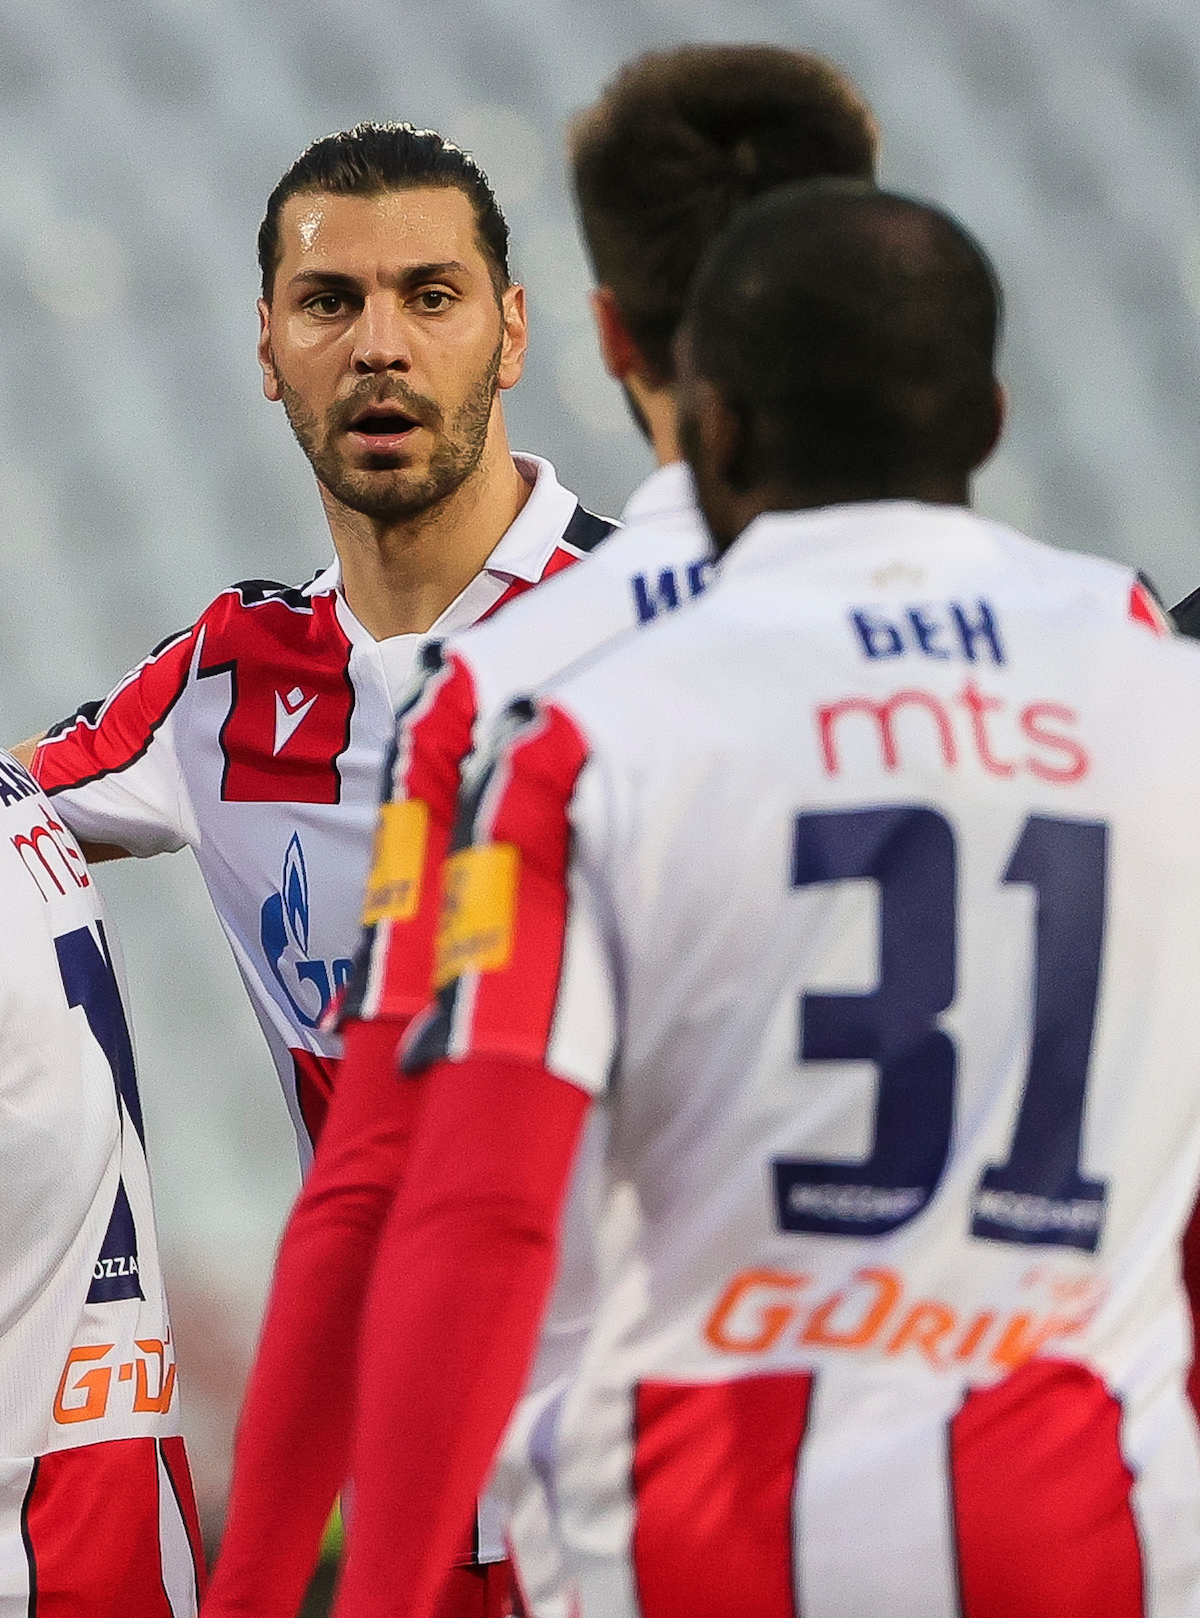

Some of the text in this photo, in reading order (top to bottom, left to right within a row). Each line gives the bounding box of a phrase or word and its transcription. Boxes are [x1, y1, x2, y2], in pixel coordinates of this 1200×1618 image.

[813, 678, 1090, 783] mts
[772, 806, 1110, 1252] 31
[93, 1256, 140, 1280] OZZA
